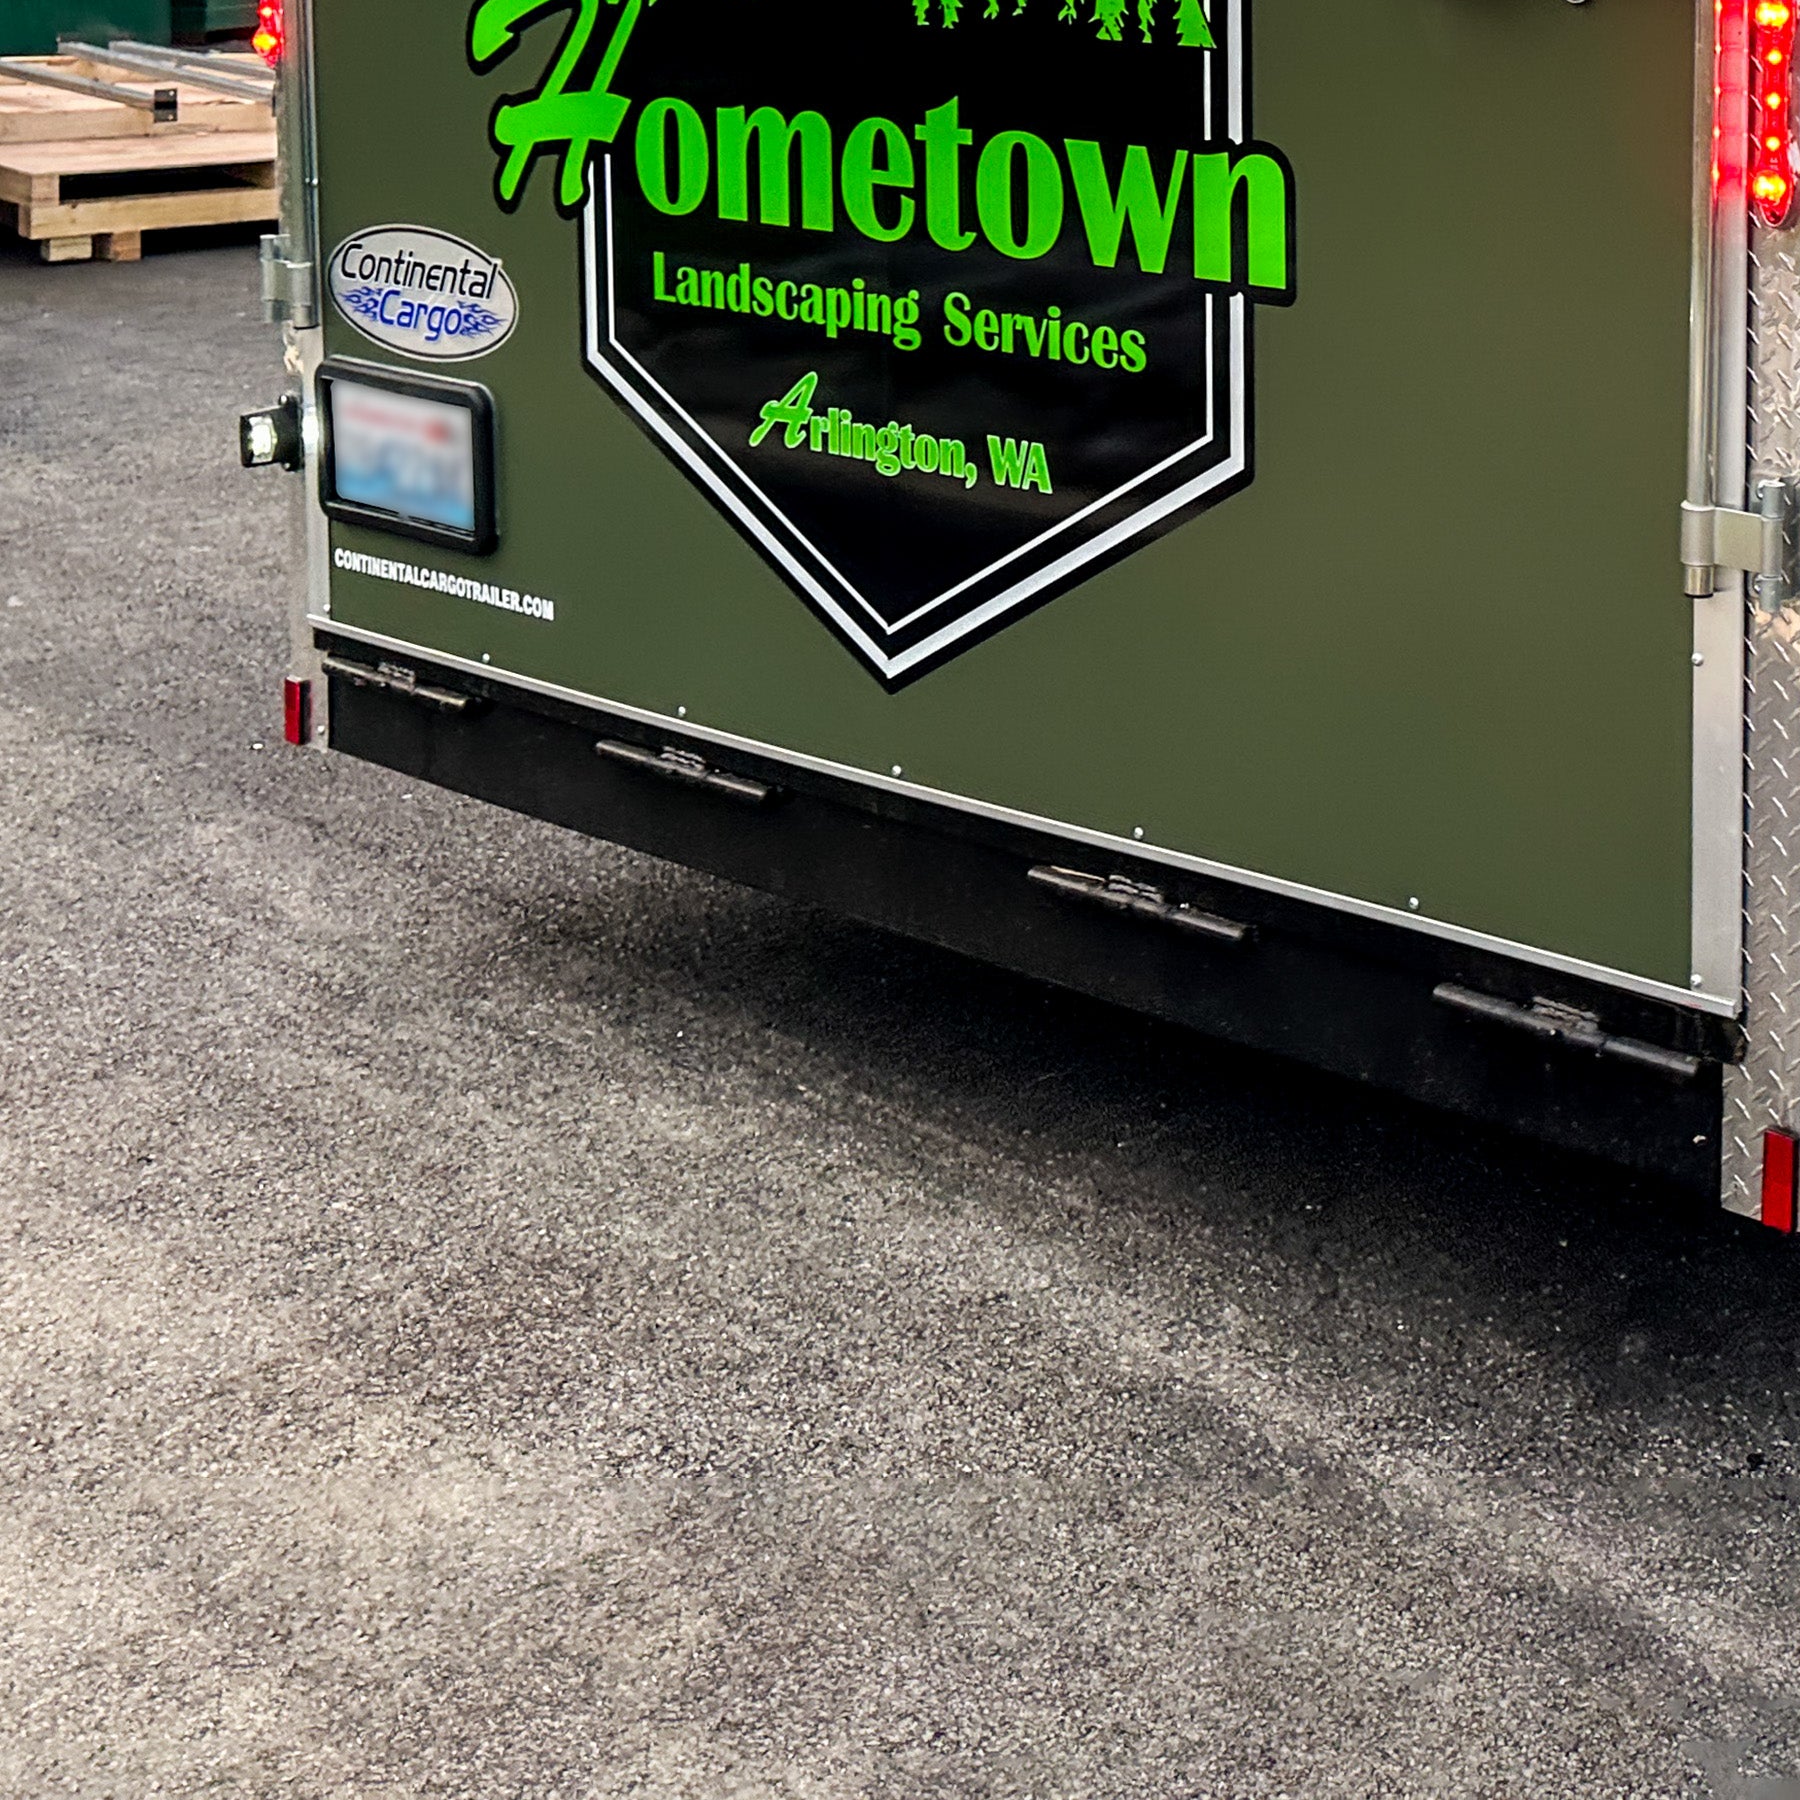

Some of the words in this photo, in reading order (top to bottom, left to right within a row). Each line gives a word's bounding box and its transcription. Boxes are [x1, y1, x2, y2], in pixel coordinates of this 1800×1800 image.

[341, 243, 500, 300] Continental
[378, 289, 463, 341] Cargo
[651, 250, 920, 351] Landscaping
[943, 291, 1148, 373] Services
[748, 371, 977, 490] Arlington,
[986, 434, 1054, 495] WA
[334, 547, 555, 622] CONTINENTALCARGOTRAILER.COM
